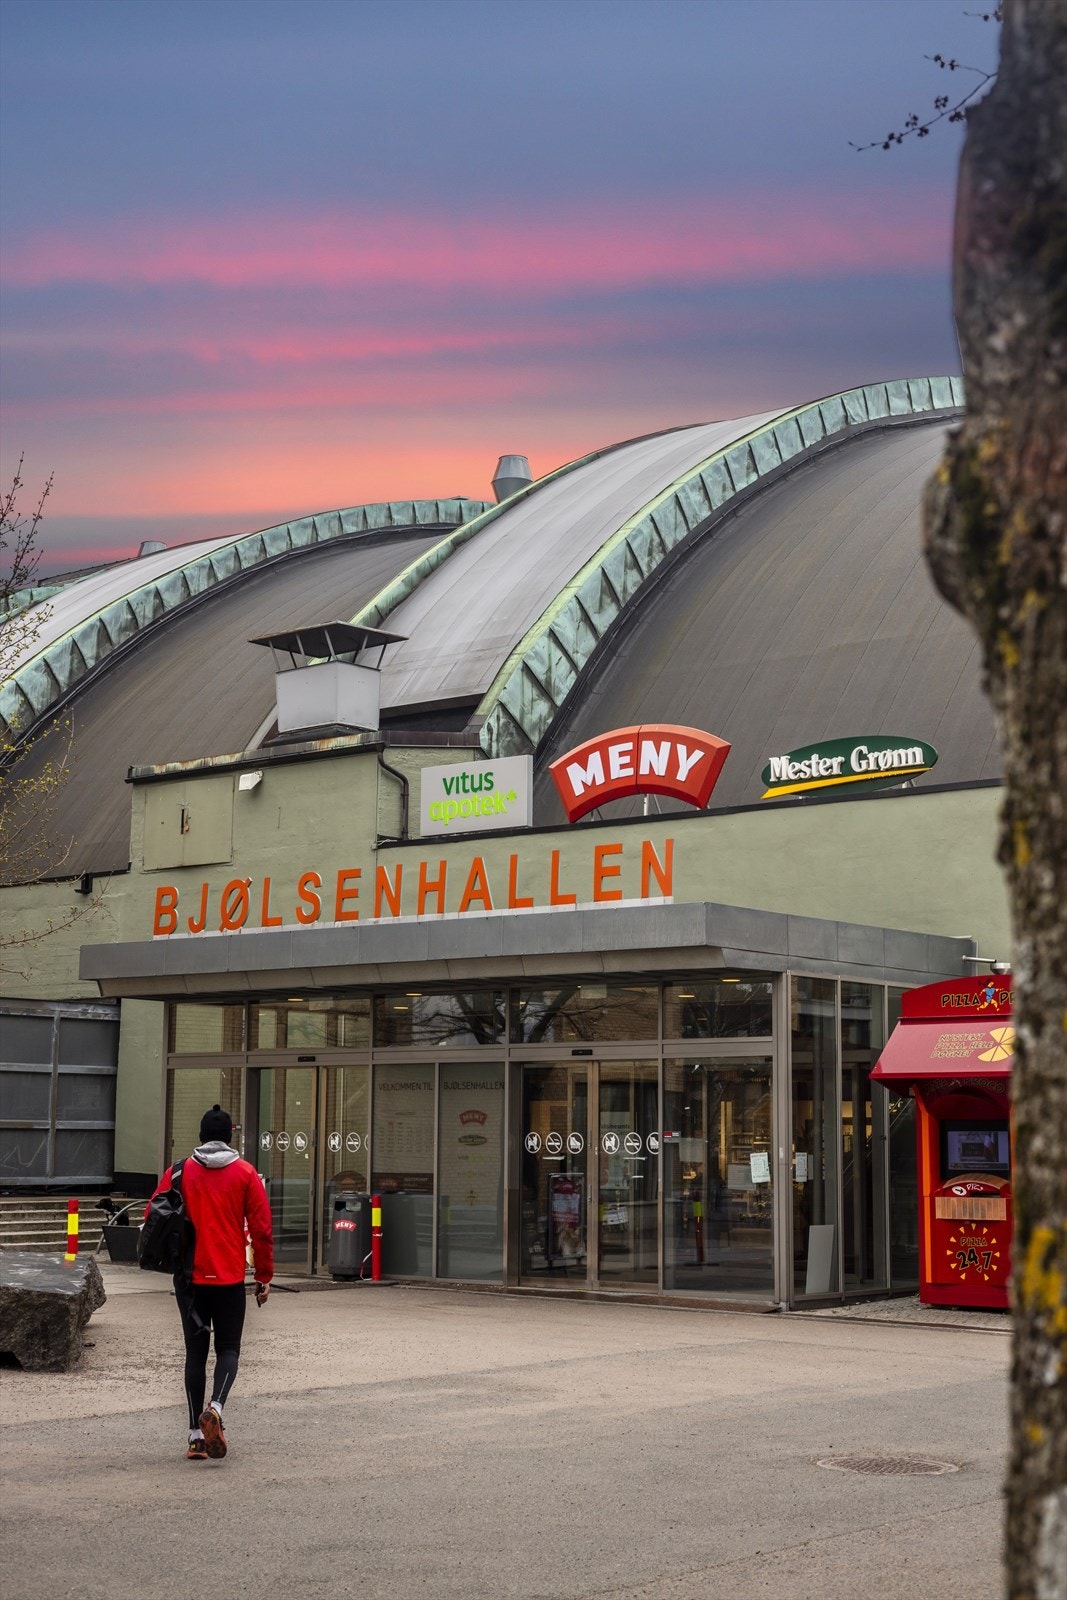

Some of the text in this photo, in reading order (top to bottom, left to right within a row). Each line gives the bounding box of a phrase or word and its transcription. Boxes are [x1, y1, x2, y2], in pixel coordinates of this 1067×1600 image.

[566, 740, 706, 796] MENY
[769, 745, 924, 782] Mester Grønn
[442, 770, 494, 796] vitus
[152, 838, 675, 935] BJØLSENHALLEN
[941, 993, 981, 1007] PIZZA
[378, 1082, 422, 1091] VELKOMMEN
[423, 1082, 433, 1091] TIL
[336, 1221, 354, 1229] MENY
[960, 1237, 987, 1246] PIZZA
